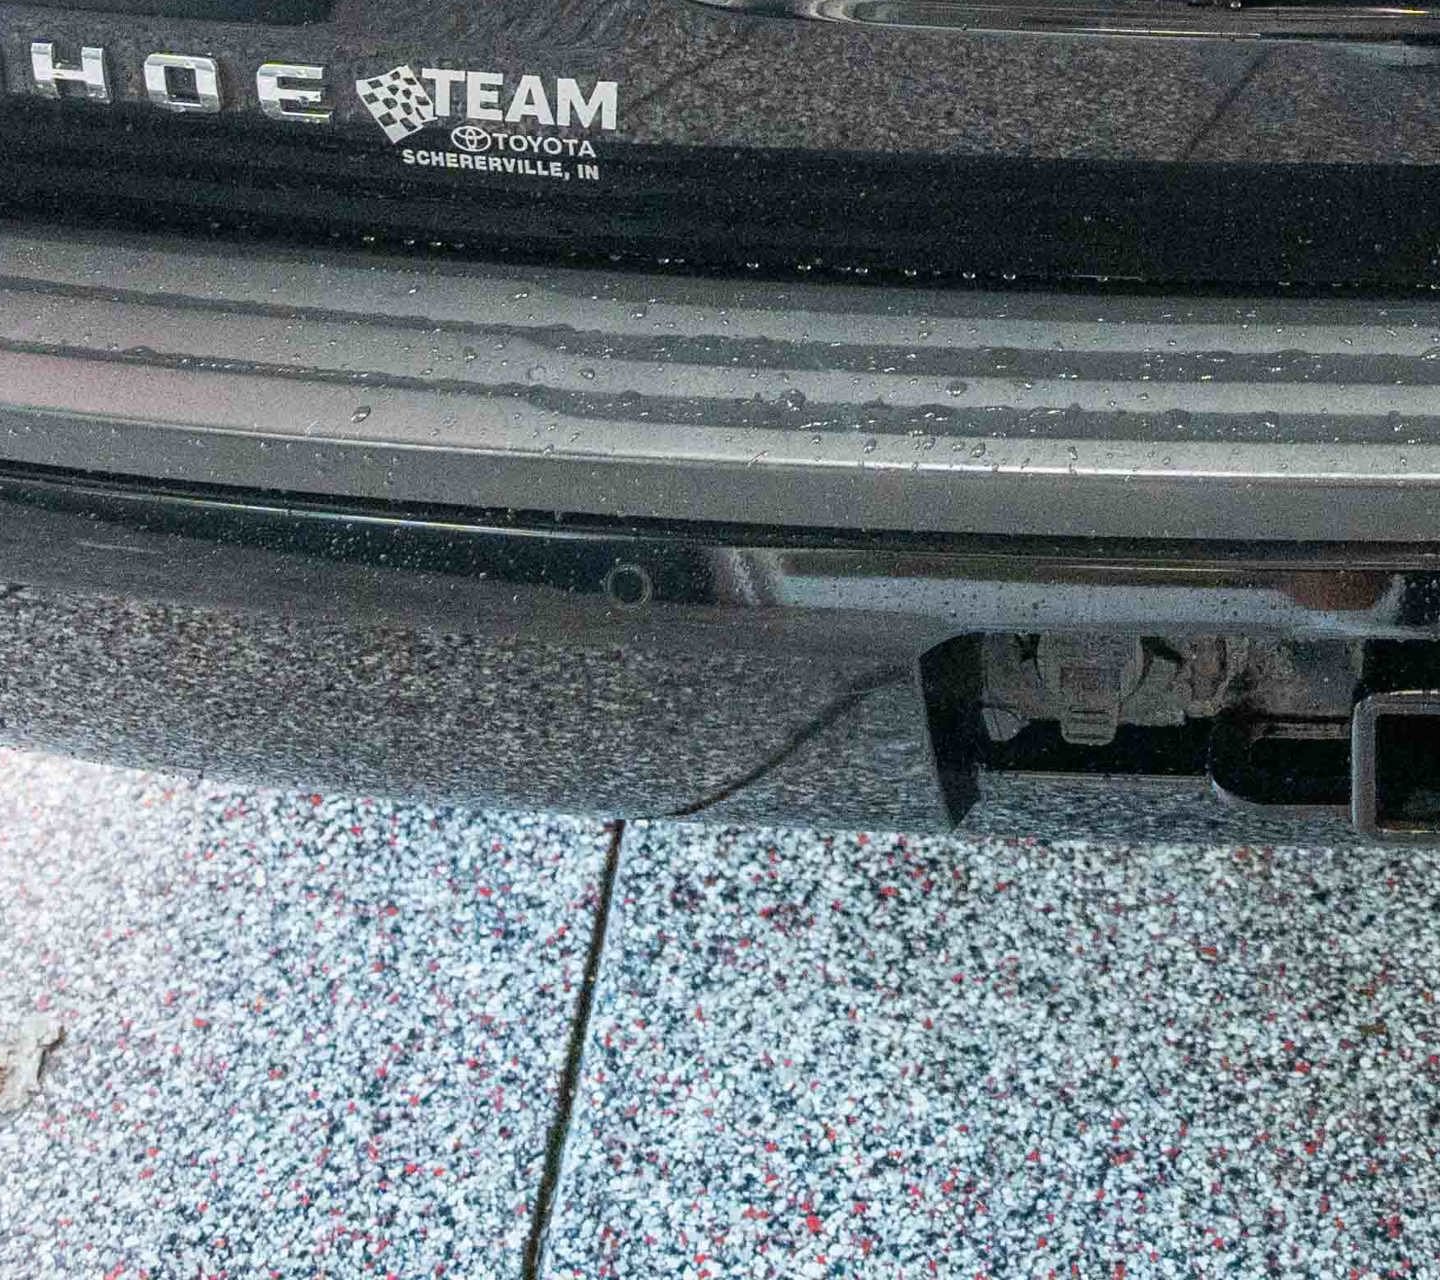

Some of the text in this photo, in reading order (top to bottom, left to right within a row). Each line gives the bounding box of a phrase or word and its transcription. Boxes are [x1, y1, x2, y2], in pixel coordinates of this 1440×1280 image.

[421, 67, 618, 130] TEAM
[492, 132, 597, 159] TOYOTA
[401, 148, 600, 181] SCHERERVILLE, IN
